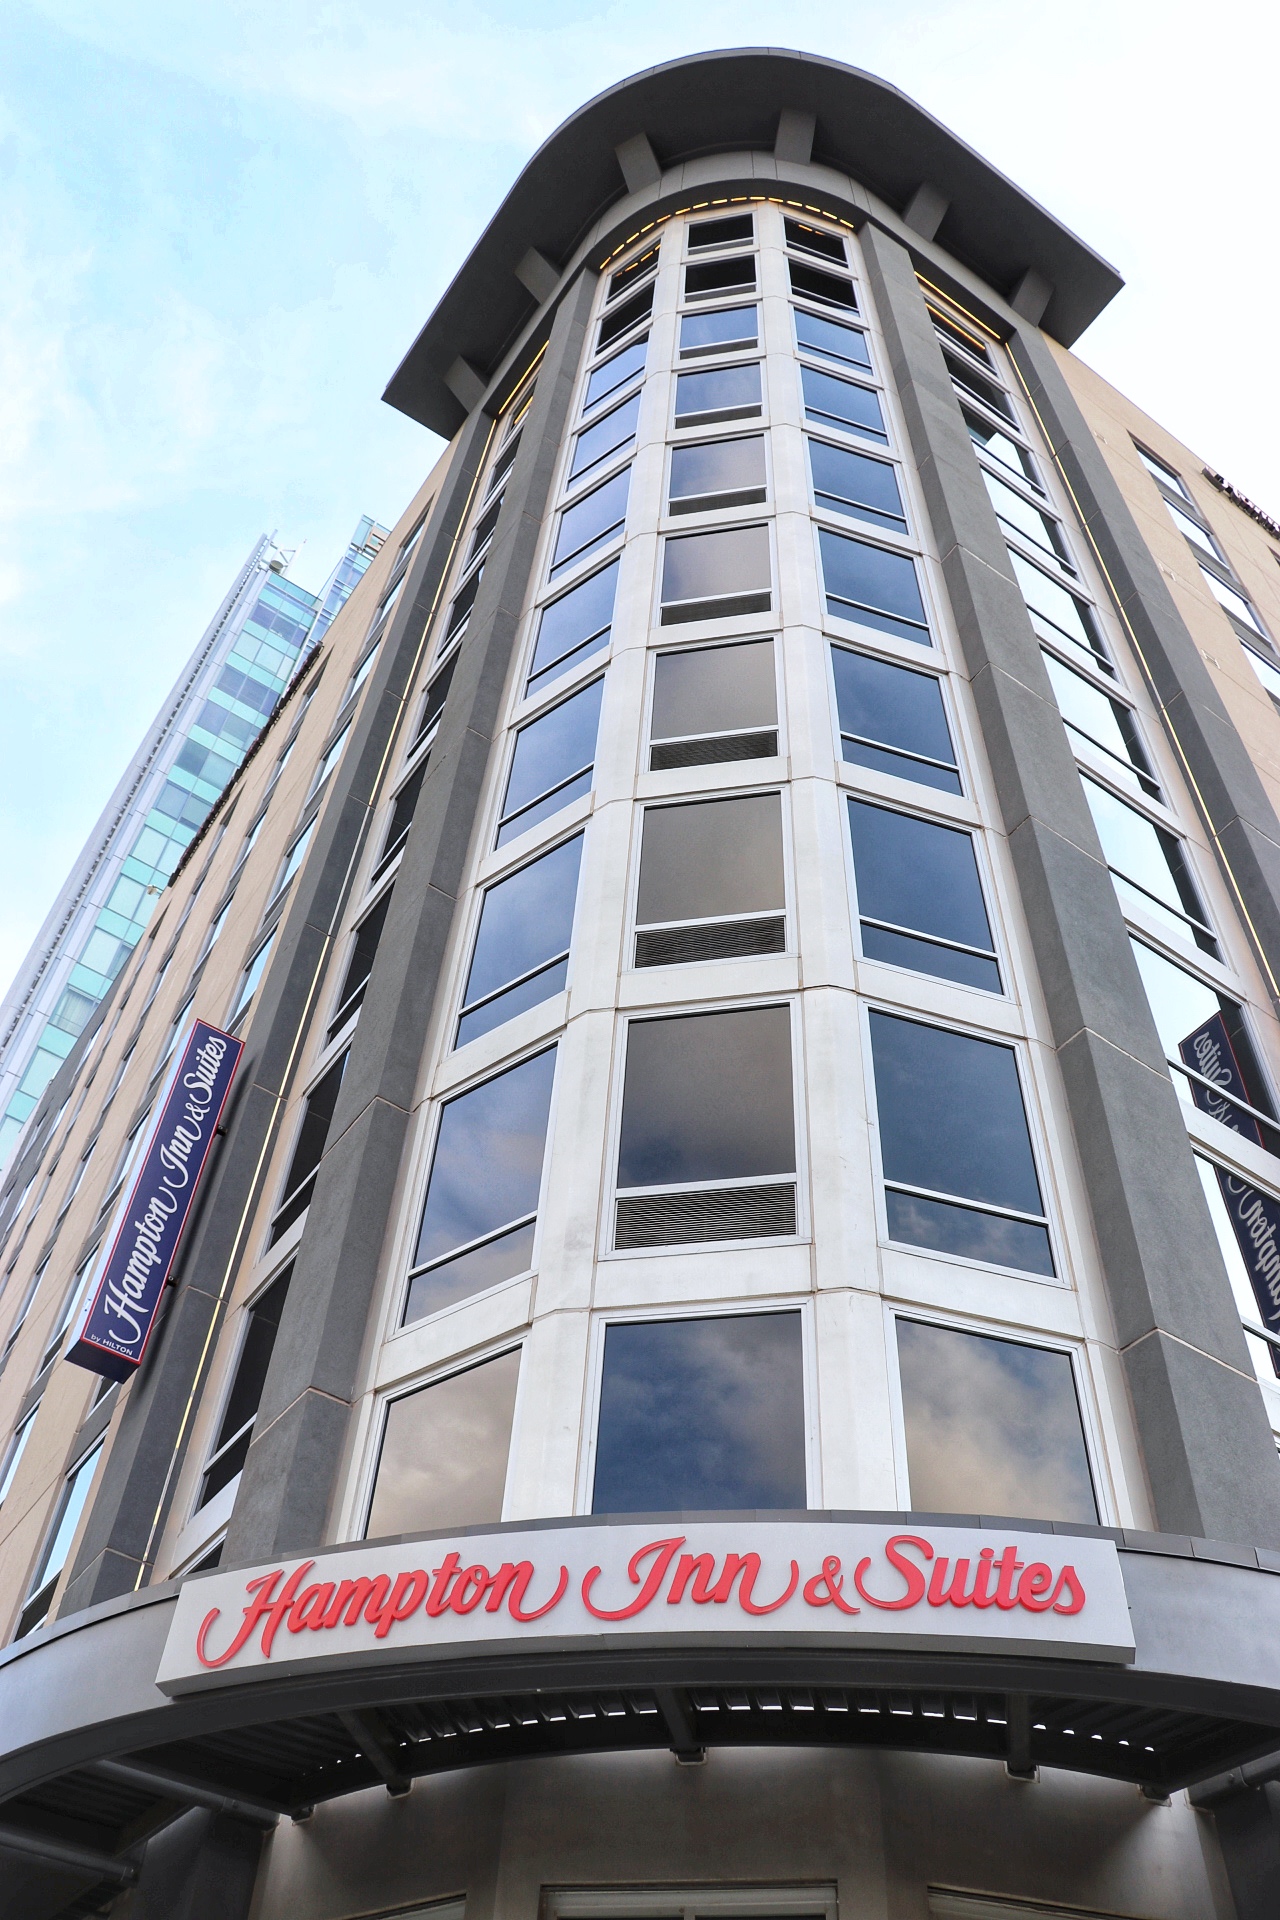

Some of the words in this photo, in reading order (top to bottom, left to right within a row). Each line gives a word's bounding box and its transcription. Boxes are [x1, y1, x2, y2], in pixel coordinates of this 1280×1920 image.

[183, 1036, 227, 1105] Suites
[184, 1102, 211, 1122] &
[161, 1115, 202, 1189] Inn
[104, 1186, 178, 1344] Hampton
[90, 1333, 101, 1344] by
[103, 1338, 133, 1356] HILTON
[196, 1552, 569, 1669] Hampton
[580, 1537, 800, 1621] Inn
[803, 1555, 861, 1615] &
[853, 1534, 1087, 1616] Suites
